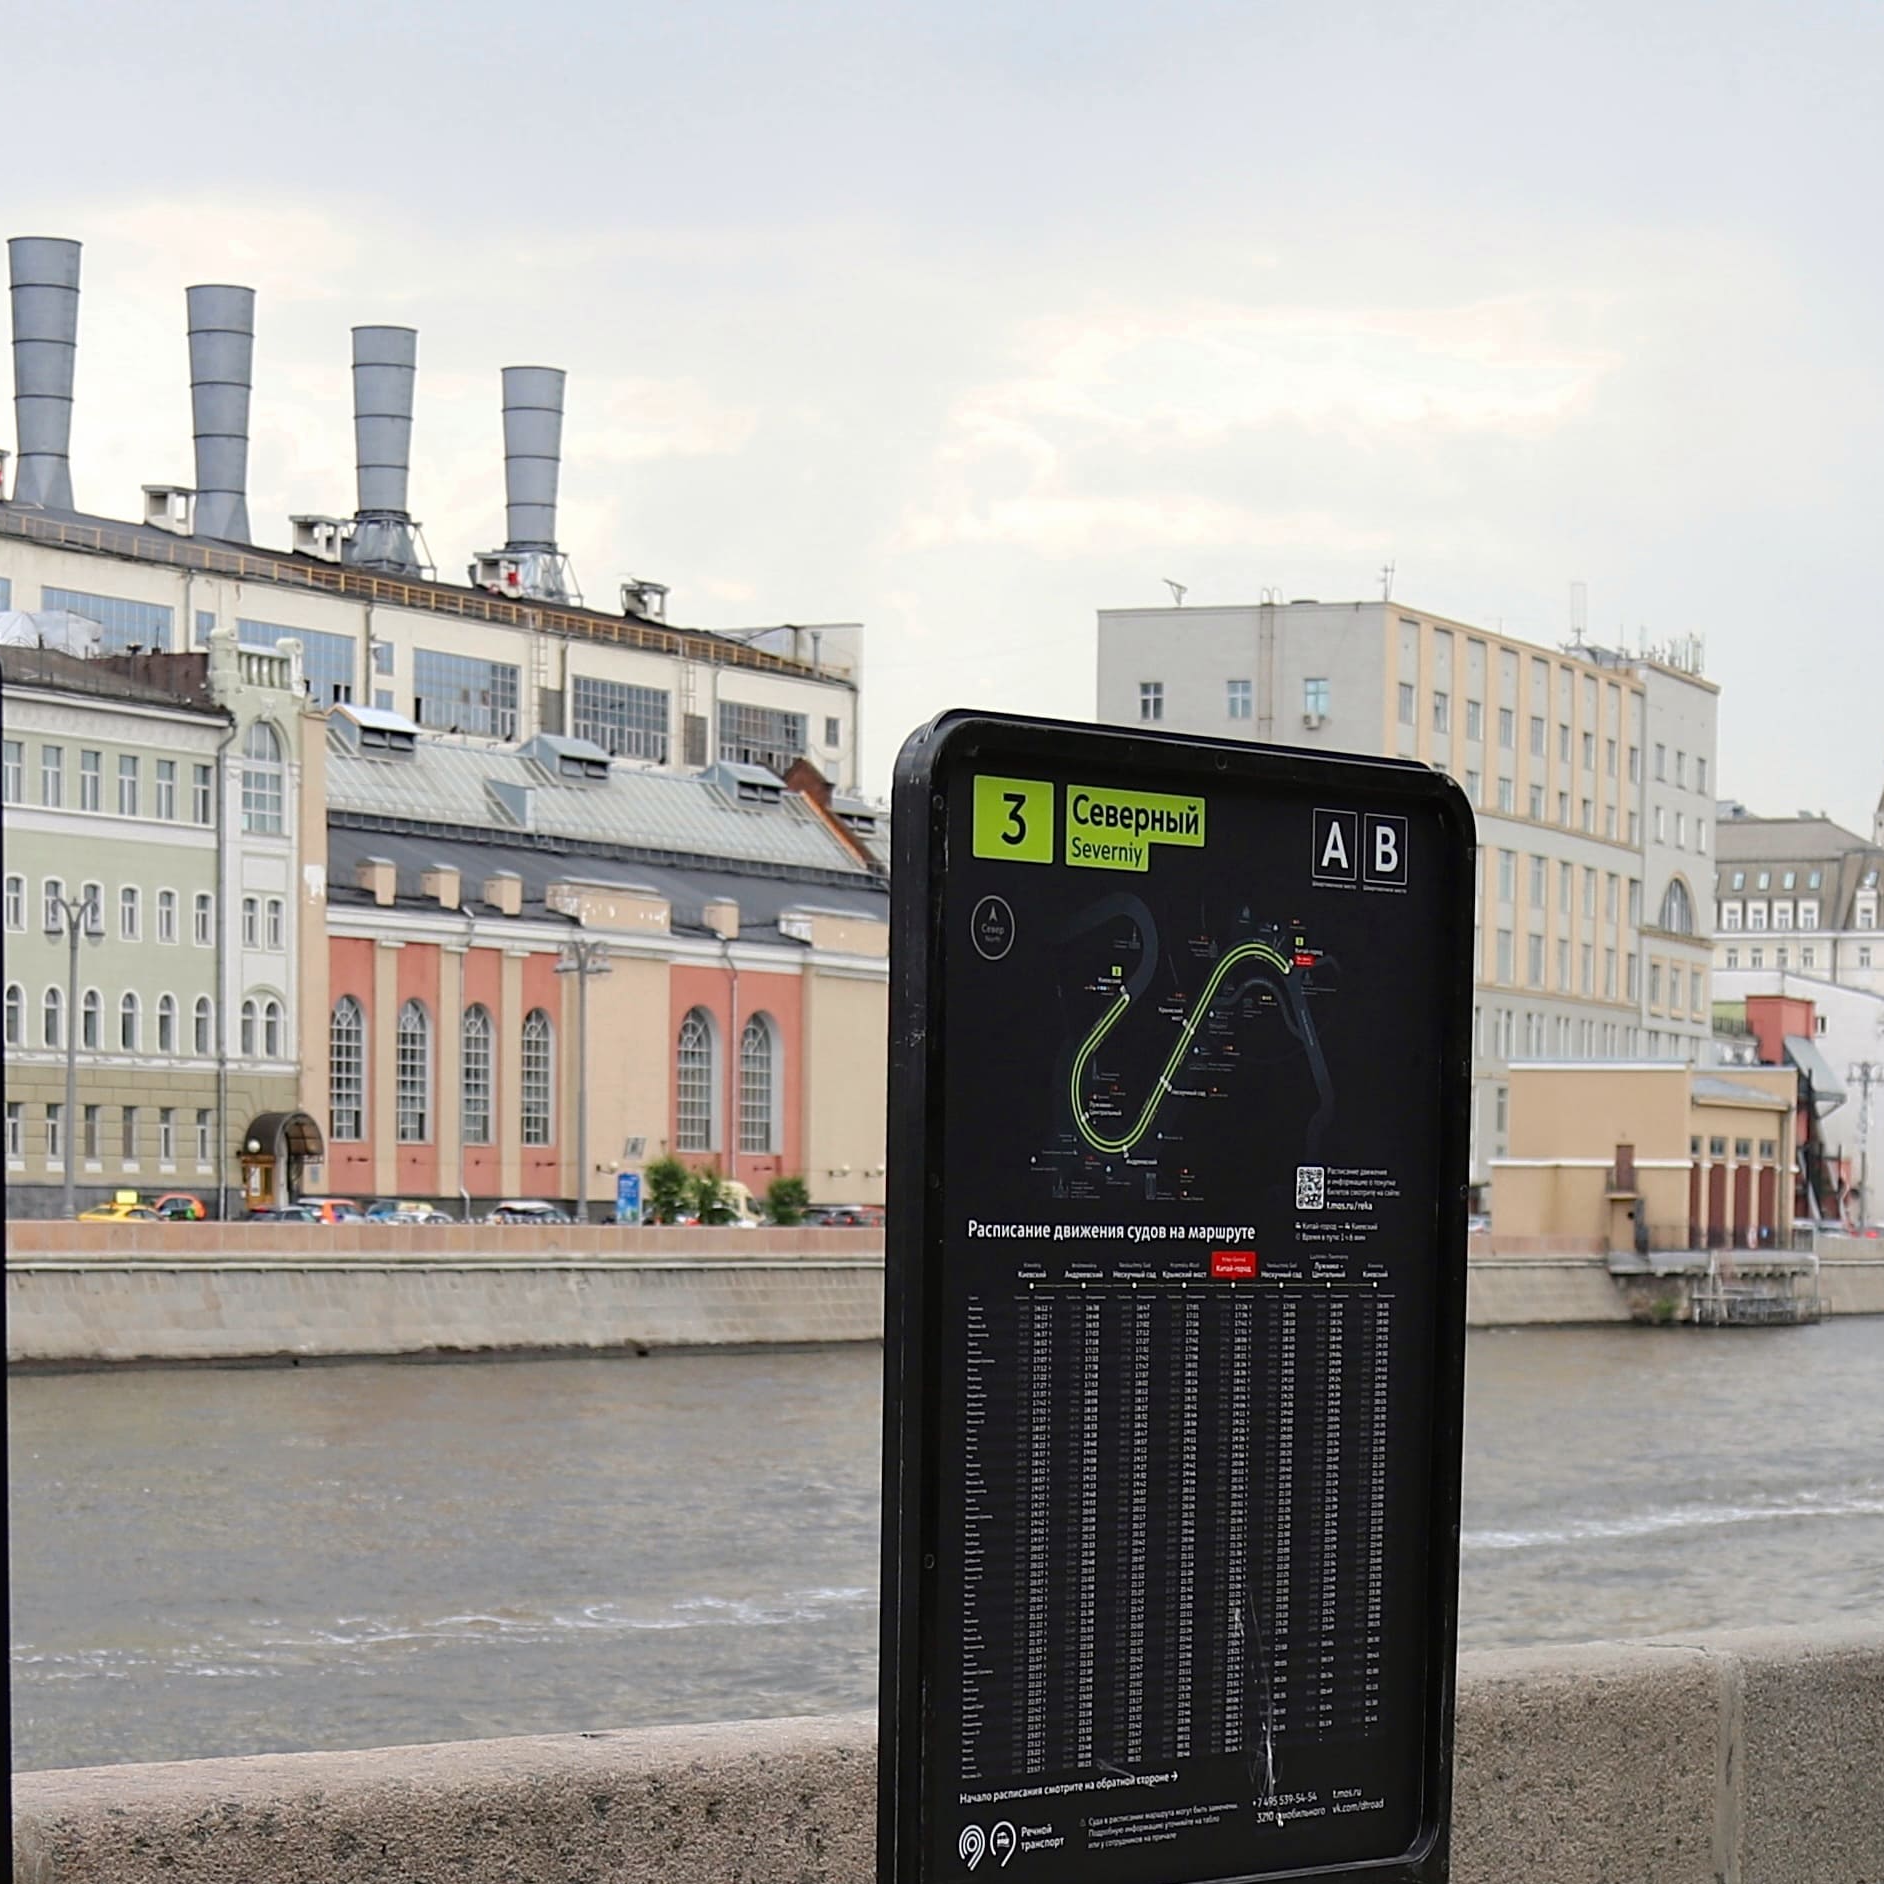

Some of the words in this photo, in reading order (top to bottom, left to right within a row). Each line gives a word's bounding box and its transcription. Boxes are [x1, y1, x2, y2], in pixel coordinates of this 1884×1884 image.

[1001, 792, 1027, 845] 3
[1072, 793, 1199, 837] Северный
[1071, 836, 1143, 867] Severniy
[980, 922, 1005, 936] Север
[1326, 1201, 1373, 1211] t.mos.ru/reka
[967, 1219, 1051, 1239] Расписание
[1053, 1224, 1124, 1242] движения
[1127, 1225, 1166, 1243] судов
[1169, 1225, 1185, 1239] на
[1188, 1225, 1256, 1243] маршруте
[1018, 1268, 1047, 1279] Киевский
[1065, 1269, 1104, 1280] Андреевский
[1113, 1269, 1144, 1280] Нескучный
[1162, 1269, 1191, 1281] Крымский
[1216, 1264, 1252, 1275] Китай-город
[1261, 1269, 1290, 1279] Нескучный
[959, 1790, 992, 1805] Начало
[993, 1785, 1043, 1804] расписания
[1044, 1781, 1083, 1797] смотрите
[1085, 1780, 1095, 1791] на
[1096, 1775, 1135, 1791] обратной
[1136, 1773, 1169, 1788] стороне
[1263, 1795, 1278, 1807] 495
[1278, 1791, 1318, 1805] 539-54-54
[1332, 1788, 1362, 1799] t.mos.ru
[1256, 1811, 1274, 1823] 3210
[1331, 1798, 1384, 1814] vk.com/dtroad
[1021, 1823, 1053, 1838] Речной
[1021, 1836, 1064, 1852] транспорт
